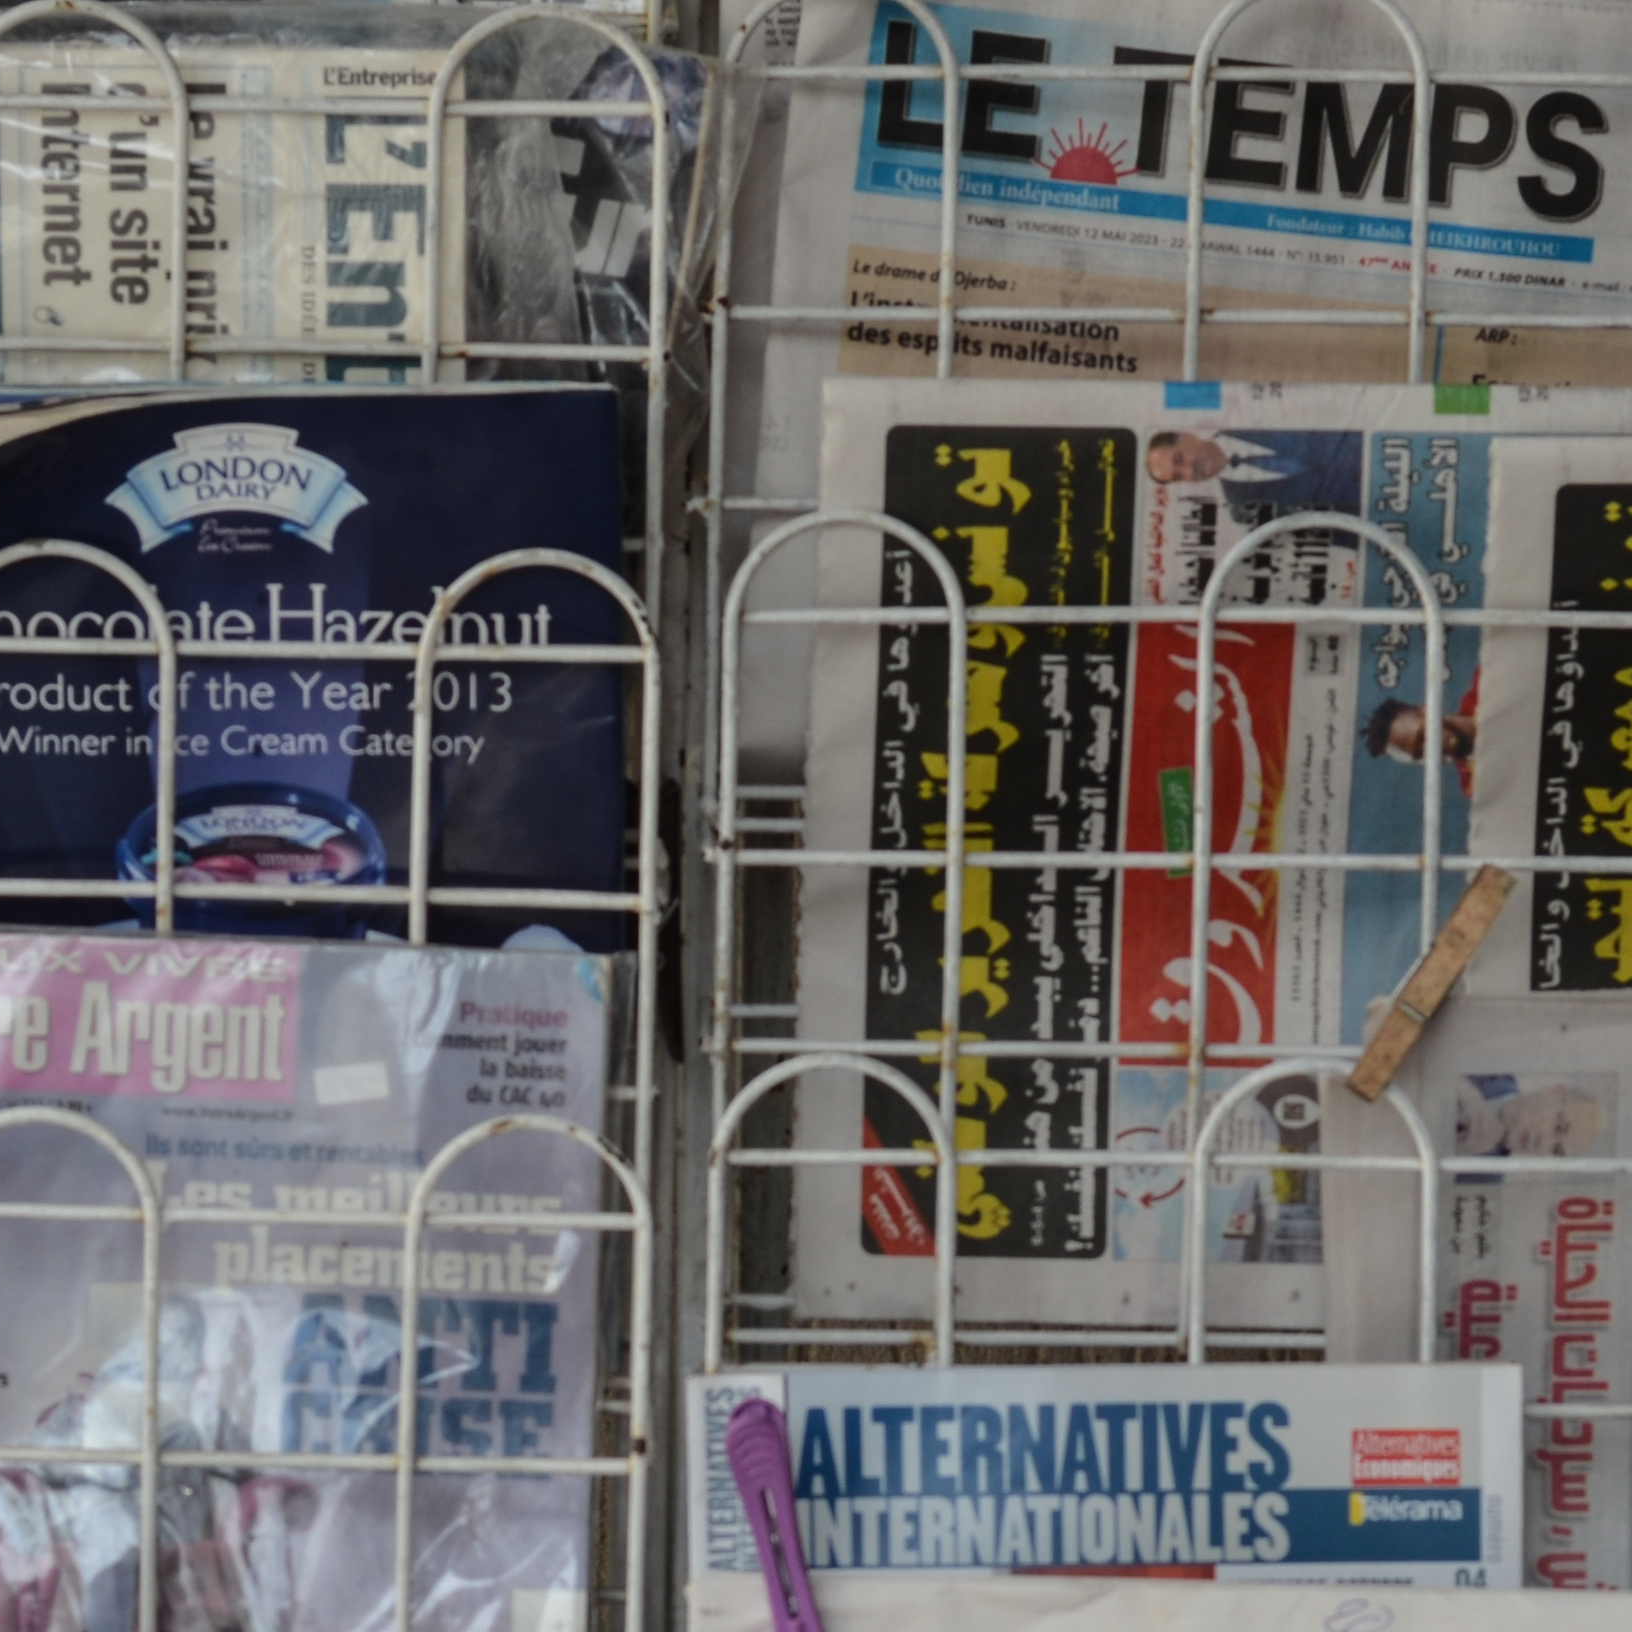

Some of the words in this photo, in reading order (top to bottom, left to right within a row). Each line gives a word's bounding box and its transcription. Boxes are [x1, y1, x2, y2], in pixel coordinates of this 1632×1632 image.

[876, 18, 1056, 160] LE
[1112, 42, 1610, 224] TEMPS
[34, 80, 96, 288] Internet
[106, 206, 176, 308] site
[874, 260, 928, 282] drame
[989, 332, 1141, 376] malfaisants
[156, 450, 314, 493] LONDON
[194, 480, 276, 510] DAIRY
[205, 671, 277, 714] the
[290, 672, 396, 714] Year
[123, 724, 153, 758] in
[218, 726, 329, 760] Cream
[338, 724, 486, 770] Cateory
[70, 980, 288, 1098] Argent
[508, 1036, 570, 1062] jouer
[477, 1057, 498, 1081] la
[502, 1056, 570, 1082] baisse
[465, 1084, 493, 1109] du
[498, 1086, 537, 1110] CAC
[210, 1226, 560, 1294] placements
[792, 1401, 1298, 1498] ALTERNATIVES
[1354, 1430, 1461, 1458] Alternatives
[794, 1494, 1295, 1570] INTERNATIONALES
